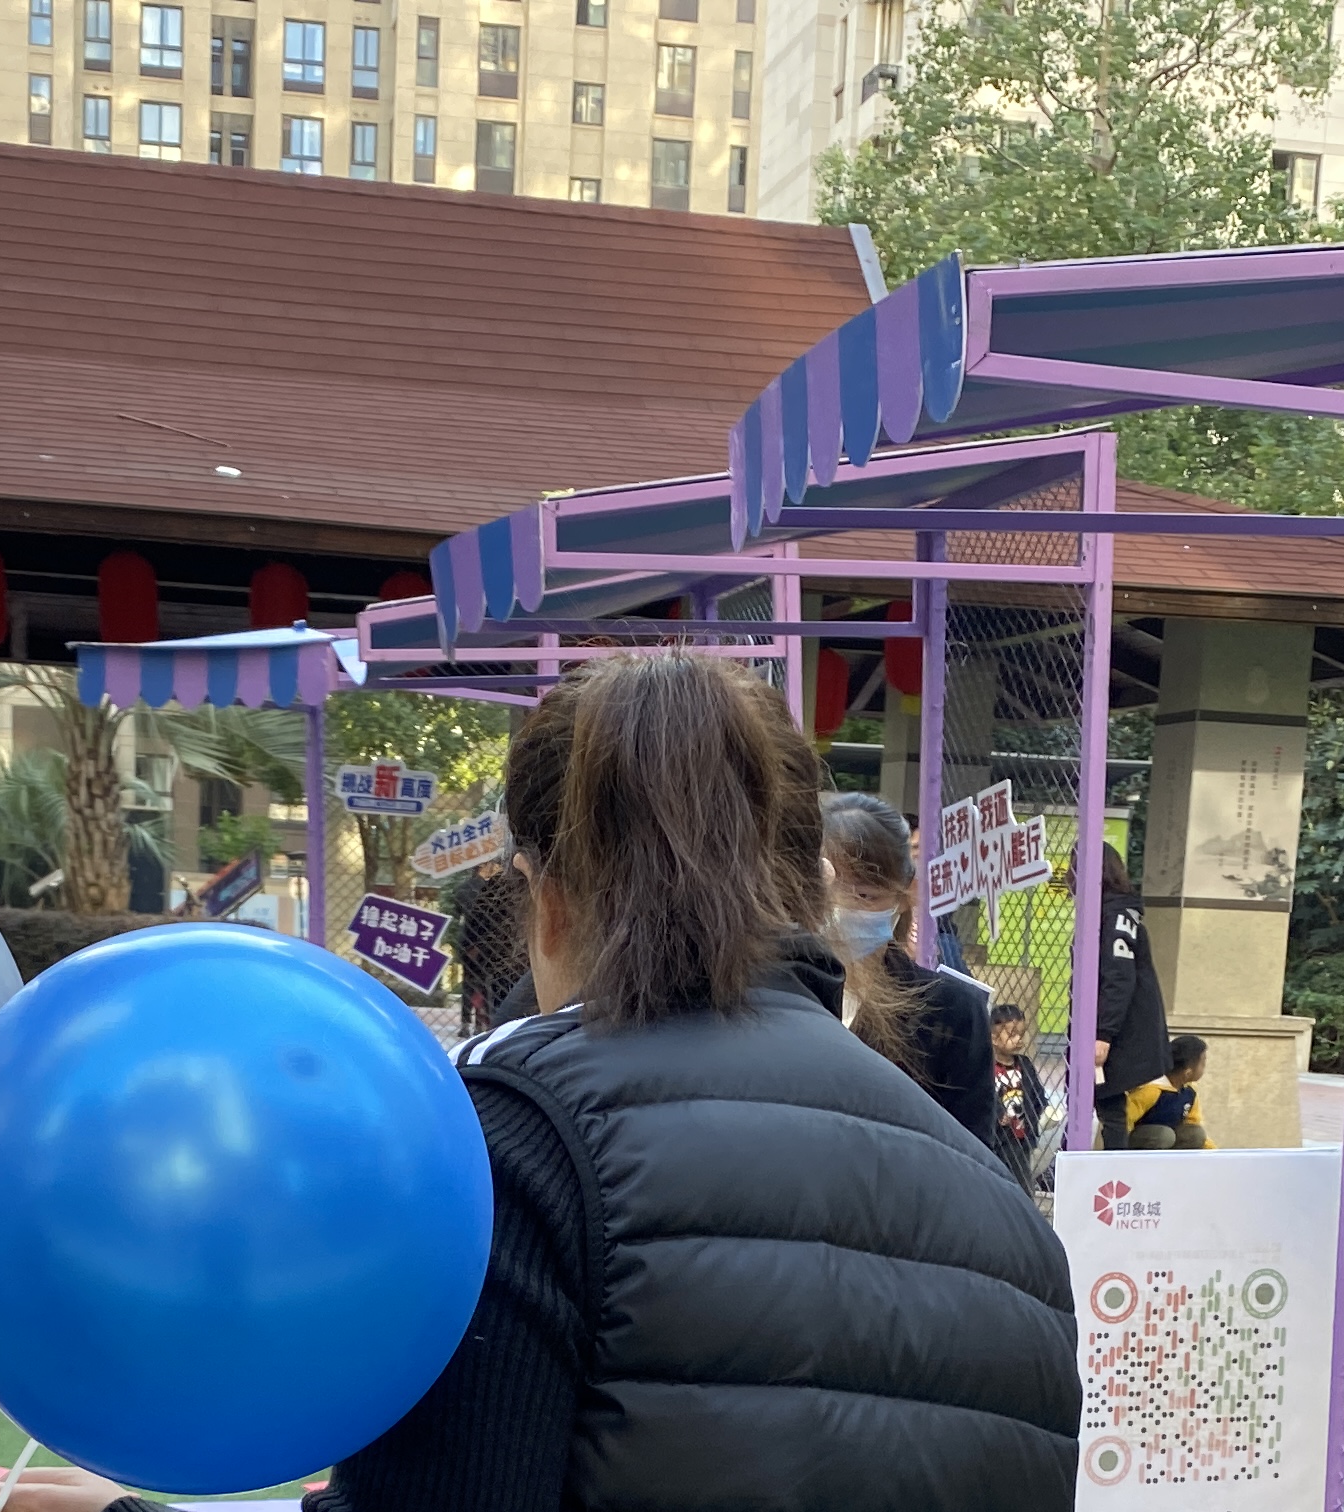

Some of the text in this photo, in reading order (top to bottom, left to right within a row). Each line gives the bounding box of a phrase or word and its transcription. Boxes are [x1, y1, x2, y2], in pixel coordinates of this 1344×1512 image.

[342, 765, 432, 798] 挑战新高度
[431, 816, 492, 854] 火力全开
[944, 806, 970, 845] 扶我
[1011, 824, 1041, 868] 能行
[930, 859, 953, 898] 起来
[360, 904, 435, 941] 撸起袖子
[373, 935, 431, 968] 加油干
[1115, 1218, 1161, 1231] INCITY
[1116, 1200, 1162, 1217] 印象城
